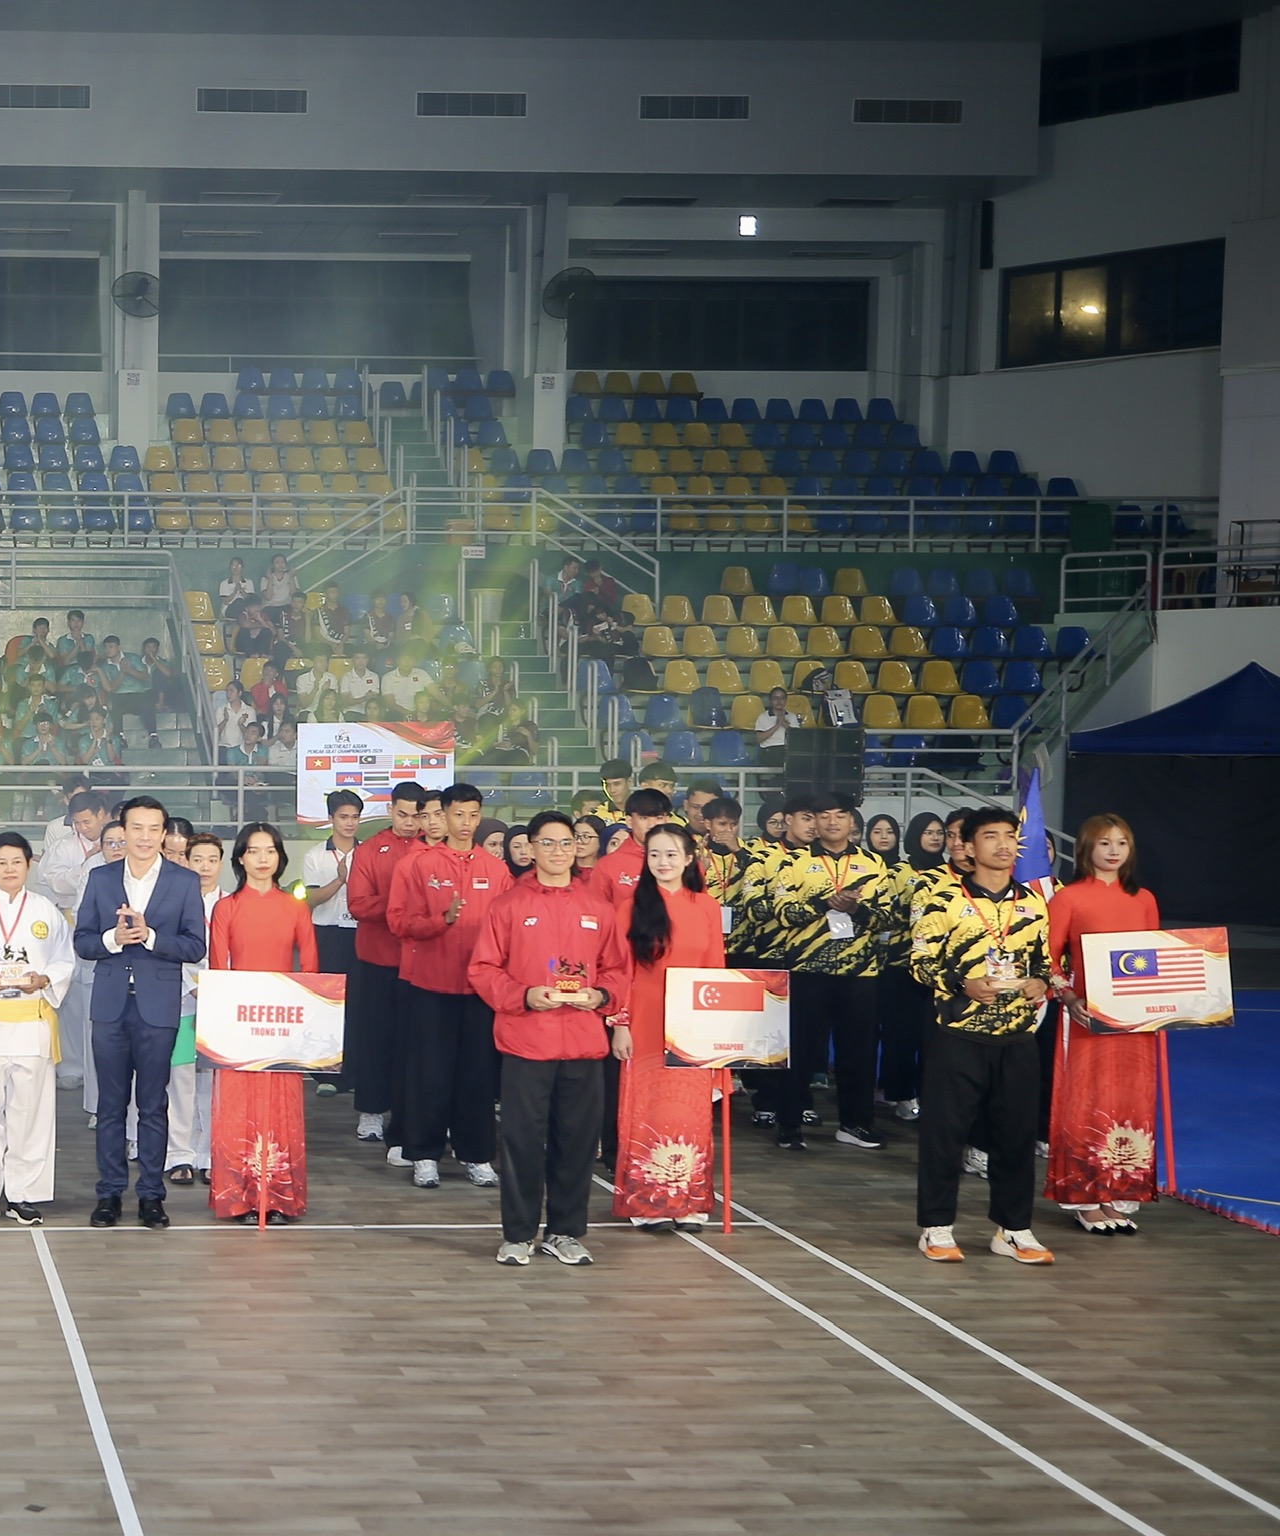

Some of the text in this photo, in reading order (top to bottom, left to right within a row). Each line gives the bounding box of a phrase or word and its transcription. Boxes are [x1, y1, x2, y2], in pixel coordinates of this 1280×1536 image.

[555, 980, 581, 990] 2026
[236, 1004, 305, 1024] REFEREE
[1145, 1004, 1177, 1014] MALAYSIA
[250, 1027, 276, 1038] TRỌNG
[713, 1043, 745, 1051] SINGAPORE
